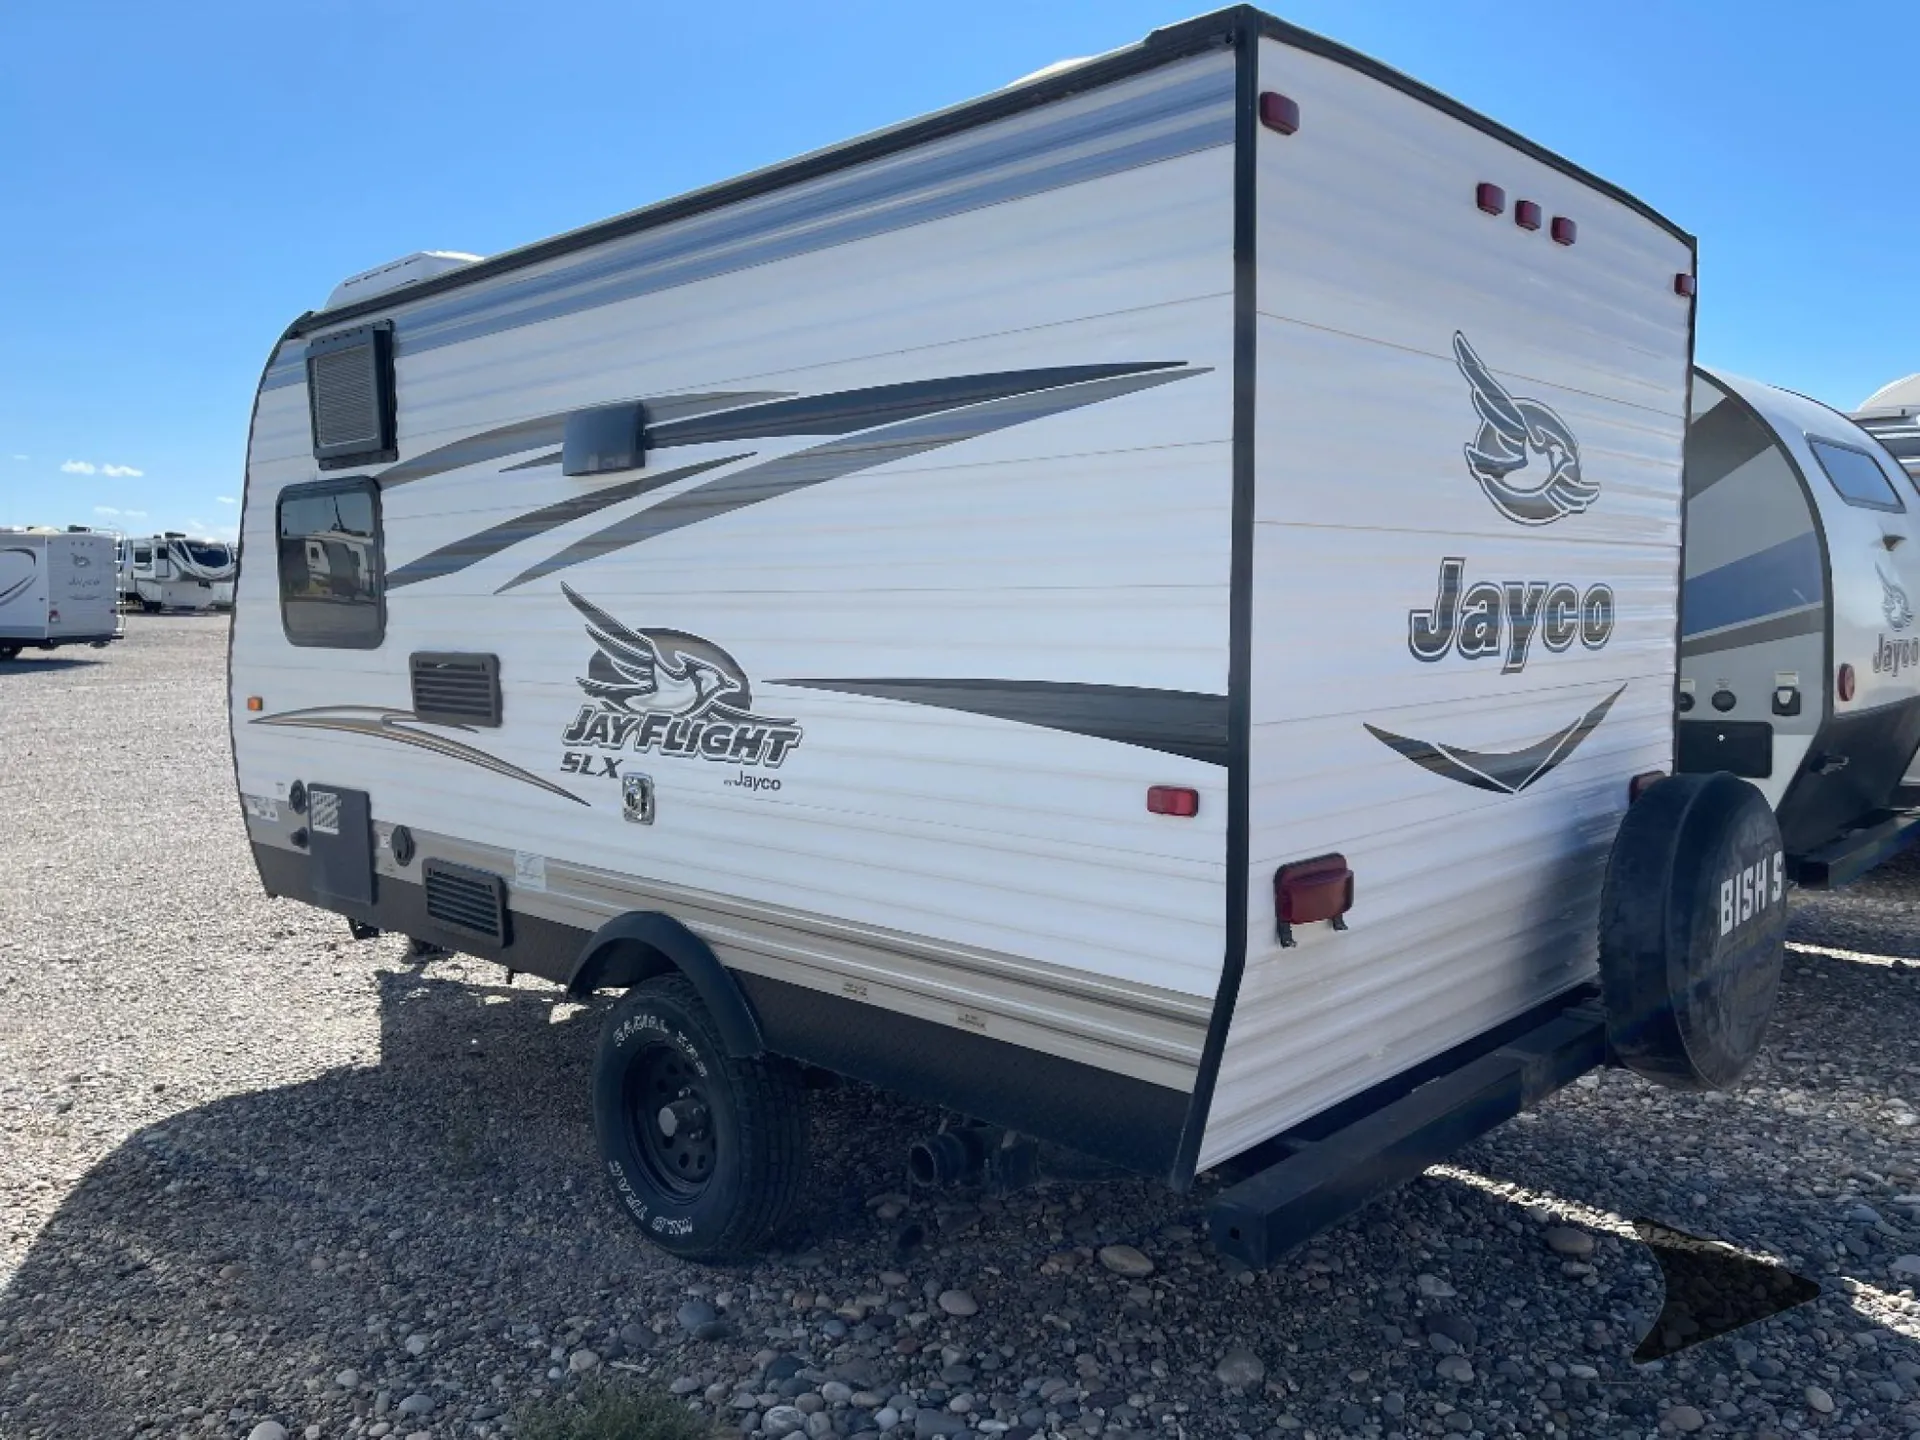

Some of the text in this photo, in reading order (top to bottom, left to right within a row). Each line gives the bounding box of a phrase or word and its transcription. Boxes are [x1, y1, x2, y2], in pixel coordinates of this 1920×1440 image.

[1408, 556, 1615, 675] Jayco
[1873, 632, 1919, 677] Jayco
[563, 705, 803, 769] JAY FLIGHT
[560, 751, 624, 779] SLX
[735, 770, 781, 791] Jayco
